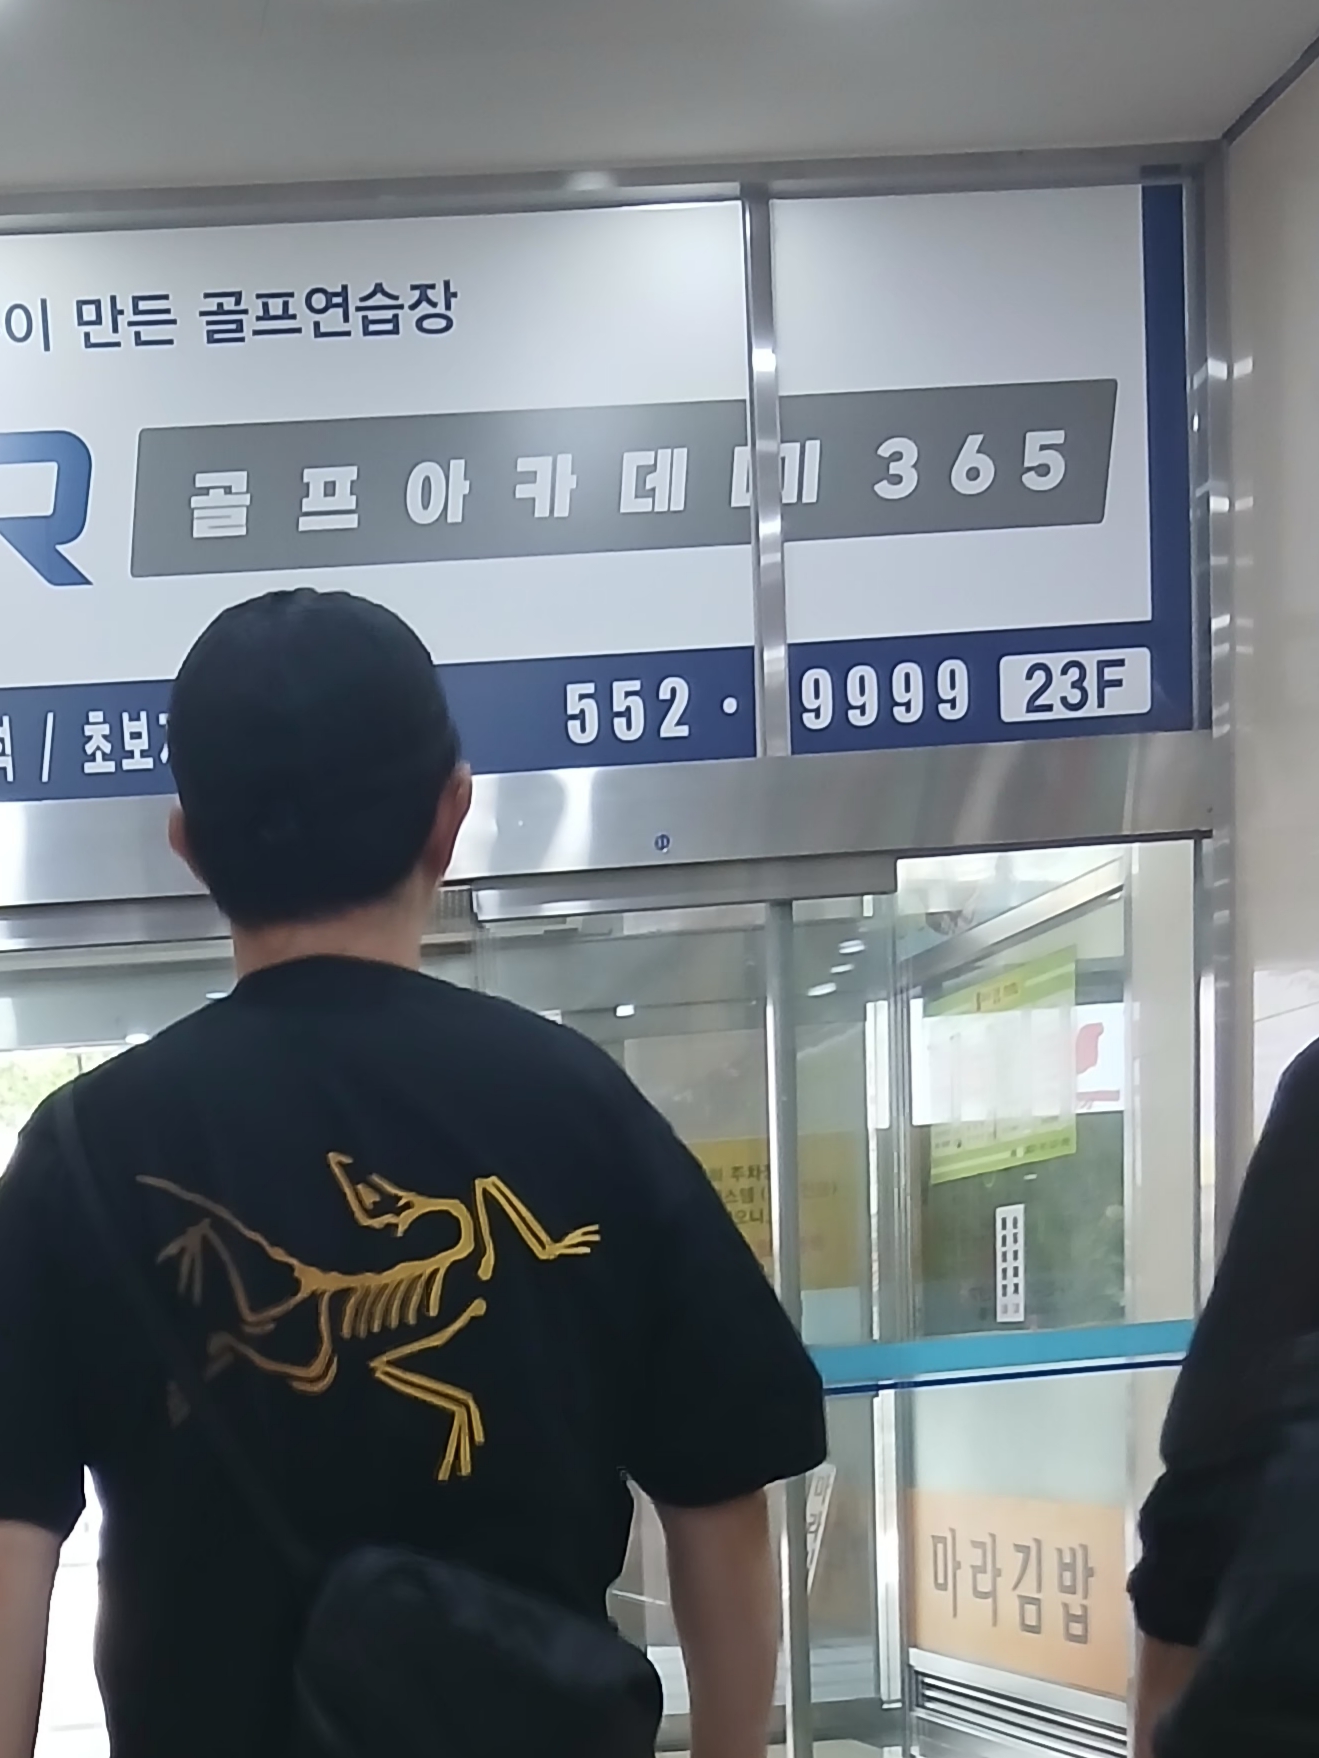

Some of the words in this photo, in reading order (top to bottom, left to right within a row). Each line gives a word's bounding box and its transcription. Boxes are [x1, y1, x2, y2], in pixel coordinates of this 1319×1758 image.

[75, 293, 179, 350] 만든
[197, 277, 459, 345] 골프연습장
[872, 429, 1068, 500] 365
[1024, 659, 1126, 715] 23F
[930, 1526, 1095, 1645] 마라김밥
